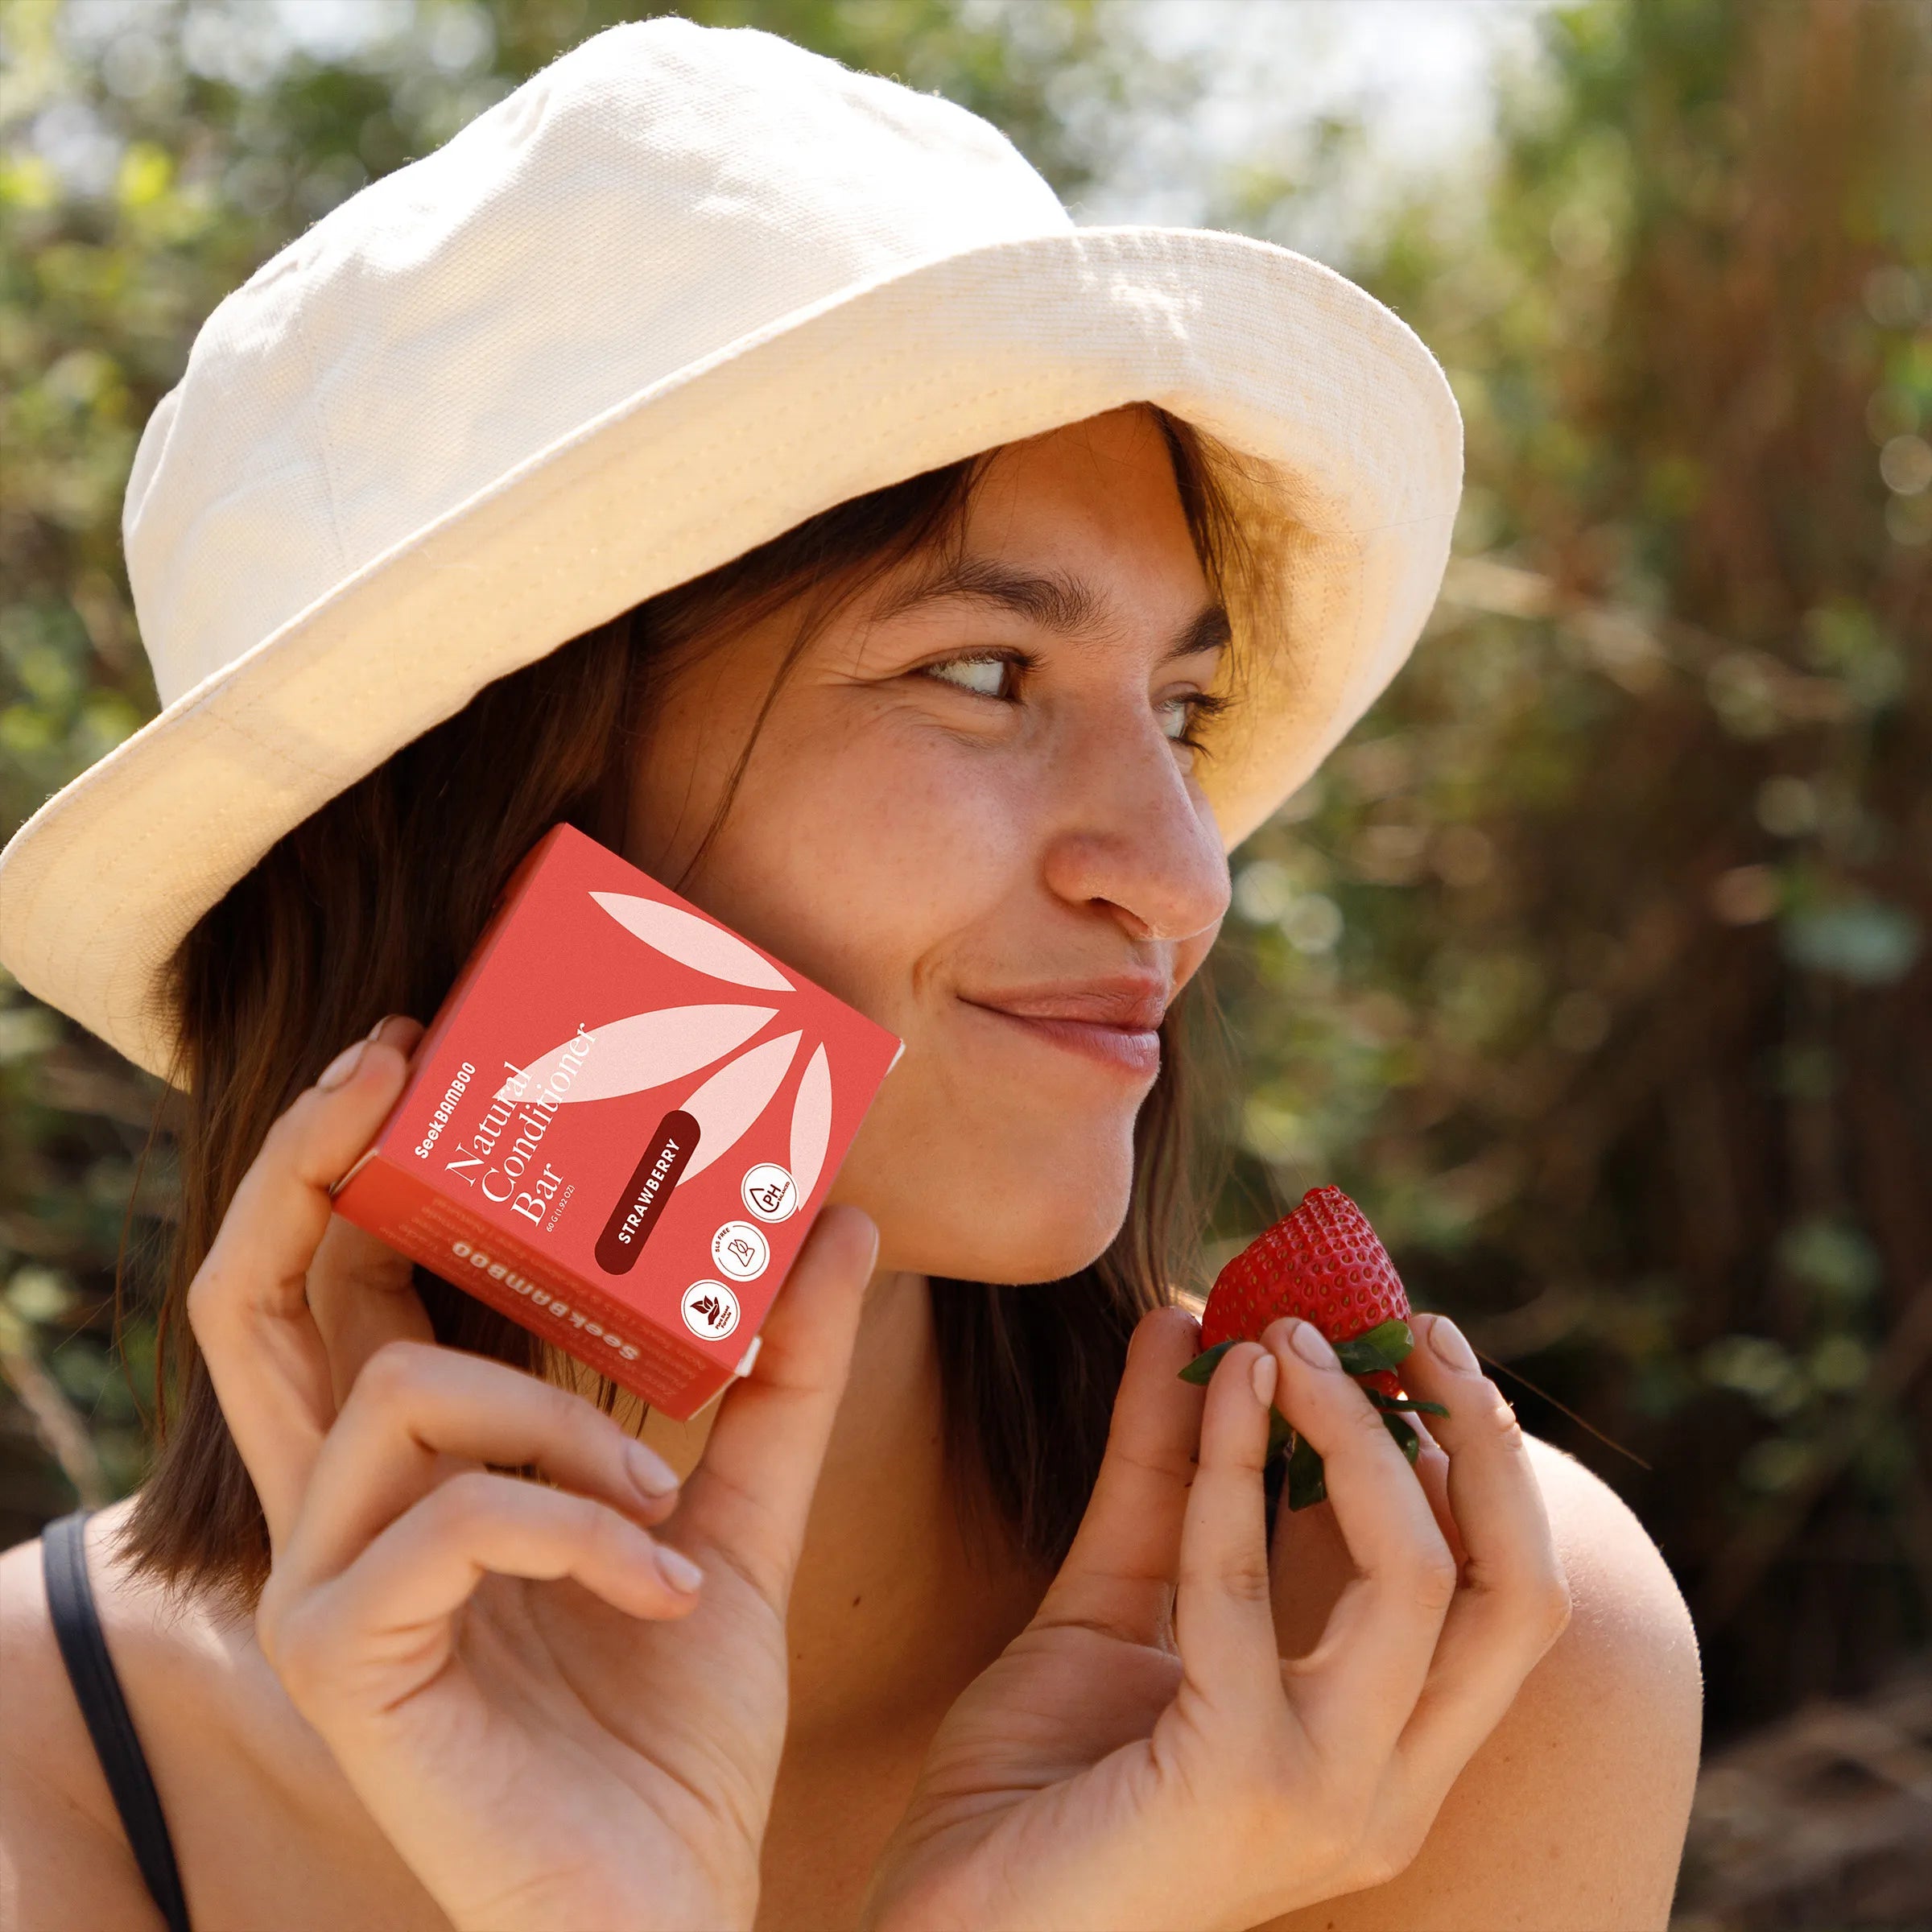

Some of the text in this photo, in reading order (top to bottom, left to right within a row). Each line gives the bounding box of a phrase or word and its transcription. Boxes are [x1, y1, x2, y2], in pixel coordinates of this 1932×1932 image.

[415, 1062, 476, 1159] SeekBAMBOO
[444, 1061, 532, 1187] Natural
[482, 1022, 597, 1202] Conditioner
[510, 1162, 564, 1227] Bar
[547, 1222, 554, 1232] 60
[554, 1198, 568, 1216] (1.92
[564, 1184, 576, 1199] OZ)
[618, 1137, 680, 1245] STRAWBERRY
[762, 1183, 782, 1207] PH
[717, 1227, 730, 1241] FREE
